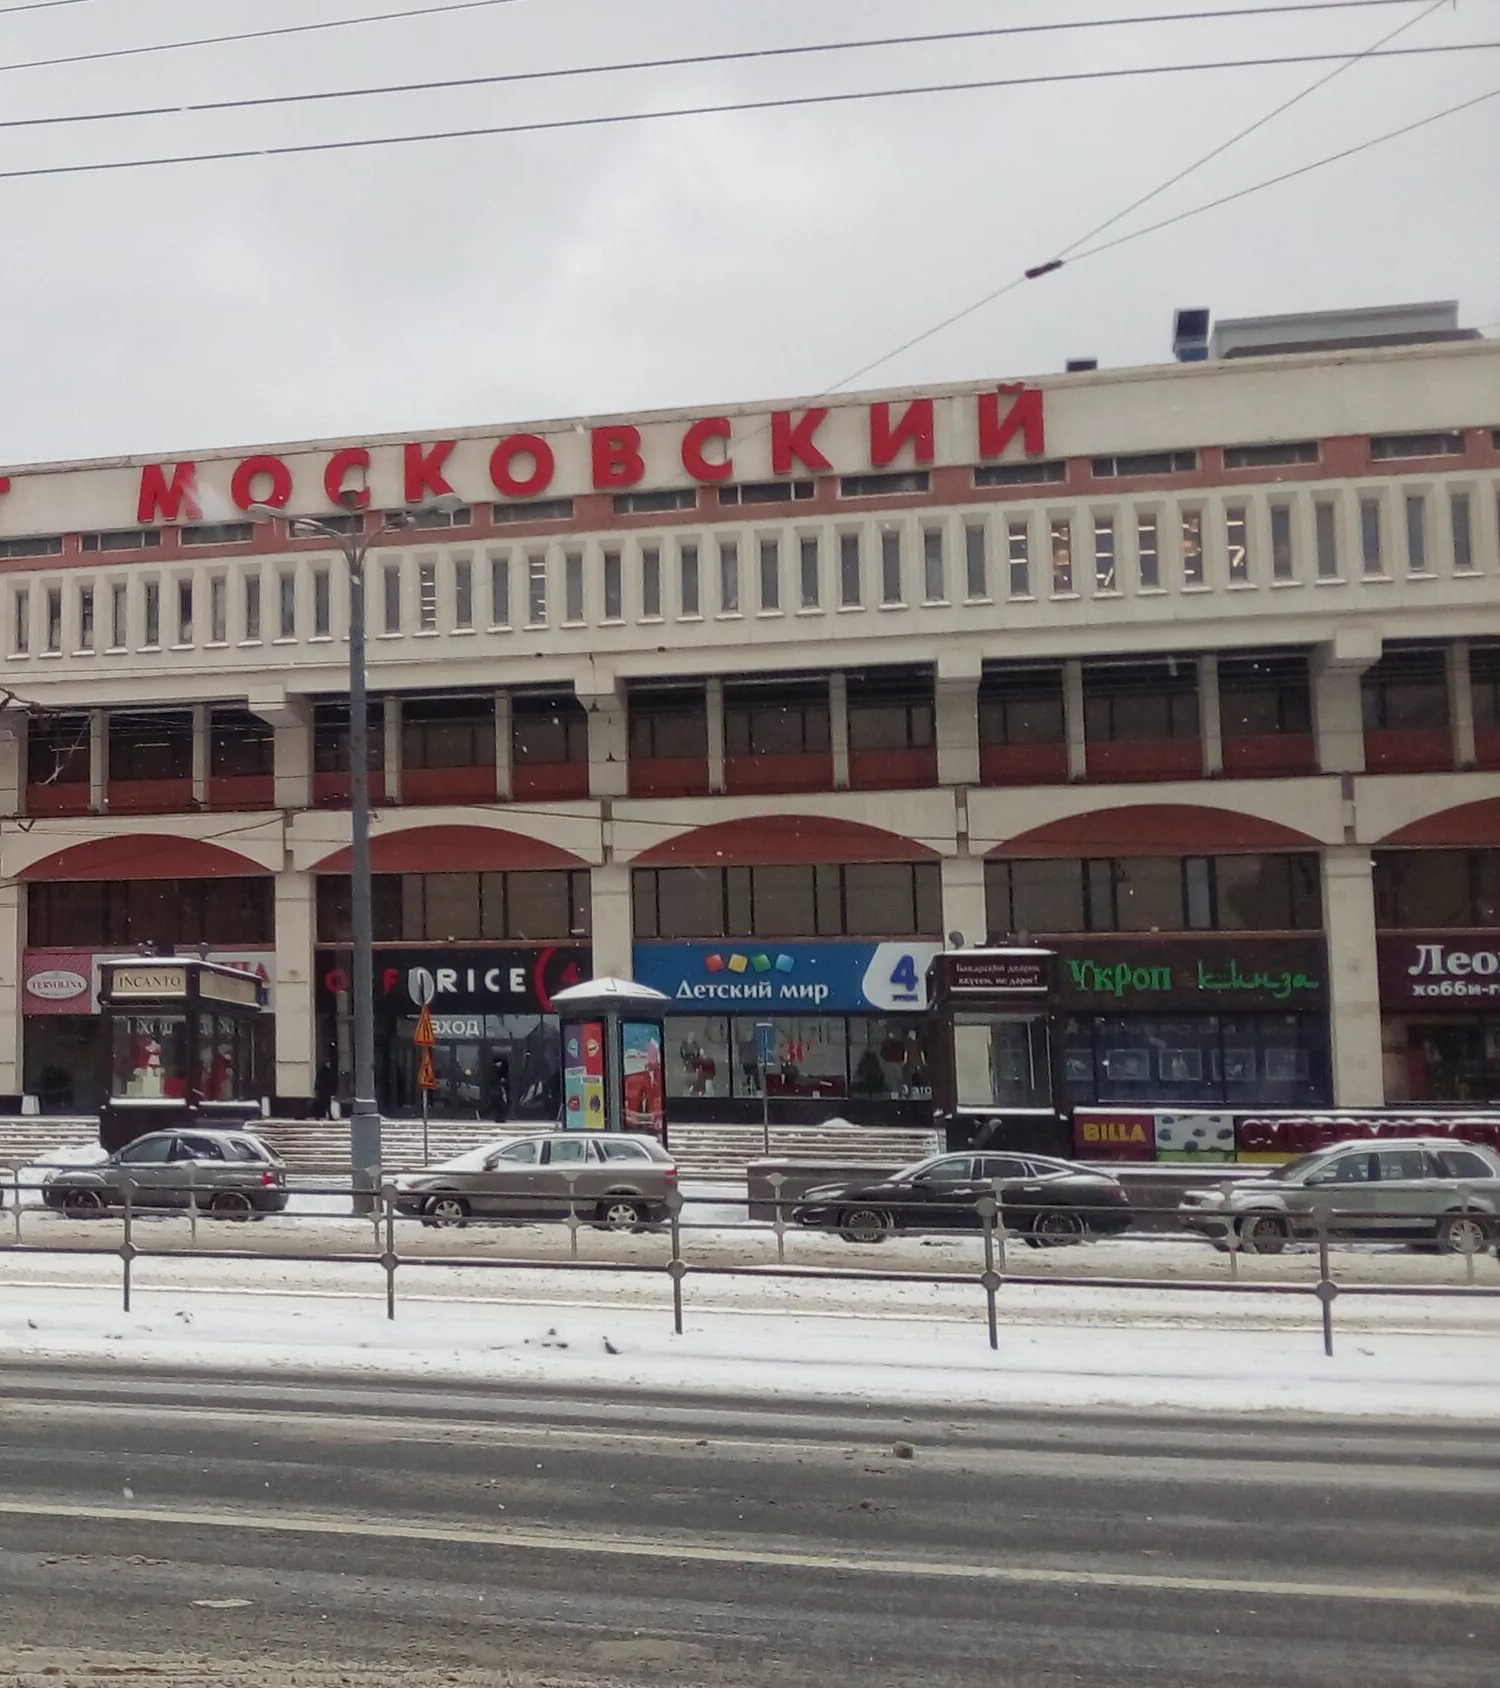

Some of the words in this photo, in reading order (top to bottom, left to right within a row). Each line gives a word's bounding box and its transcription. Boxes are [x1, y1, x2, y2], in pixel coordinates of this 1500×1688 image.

[137, 381, 1046, 524] МОСКОВСКИЙ
[891, 955, 919, 992] 4
[1408, 945, 1500, 975] Лео
[119, 975, 181, 988] INCANTO
[676, 980, 772, 999] Детский
[779, 983, 829, 1004] мир
[1083, 1122, 1147, 1142] BILLA
